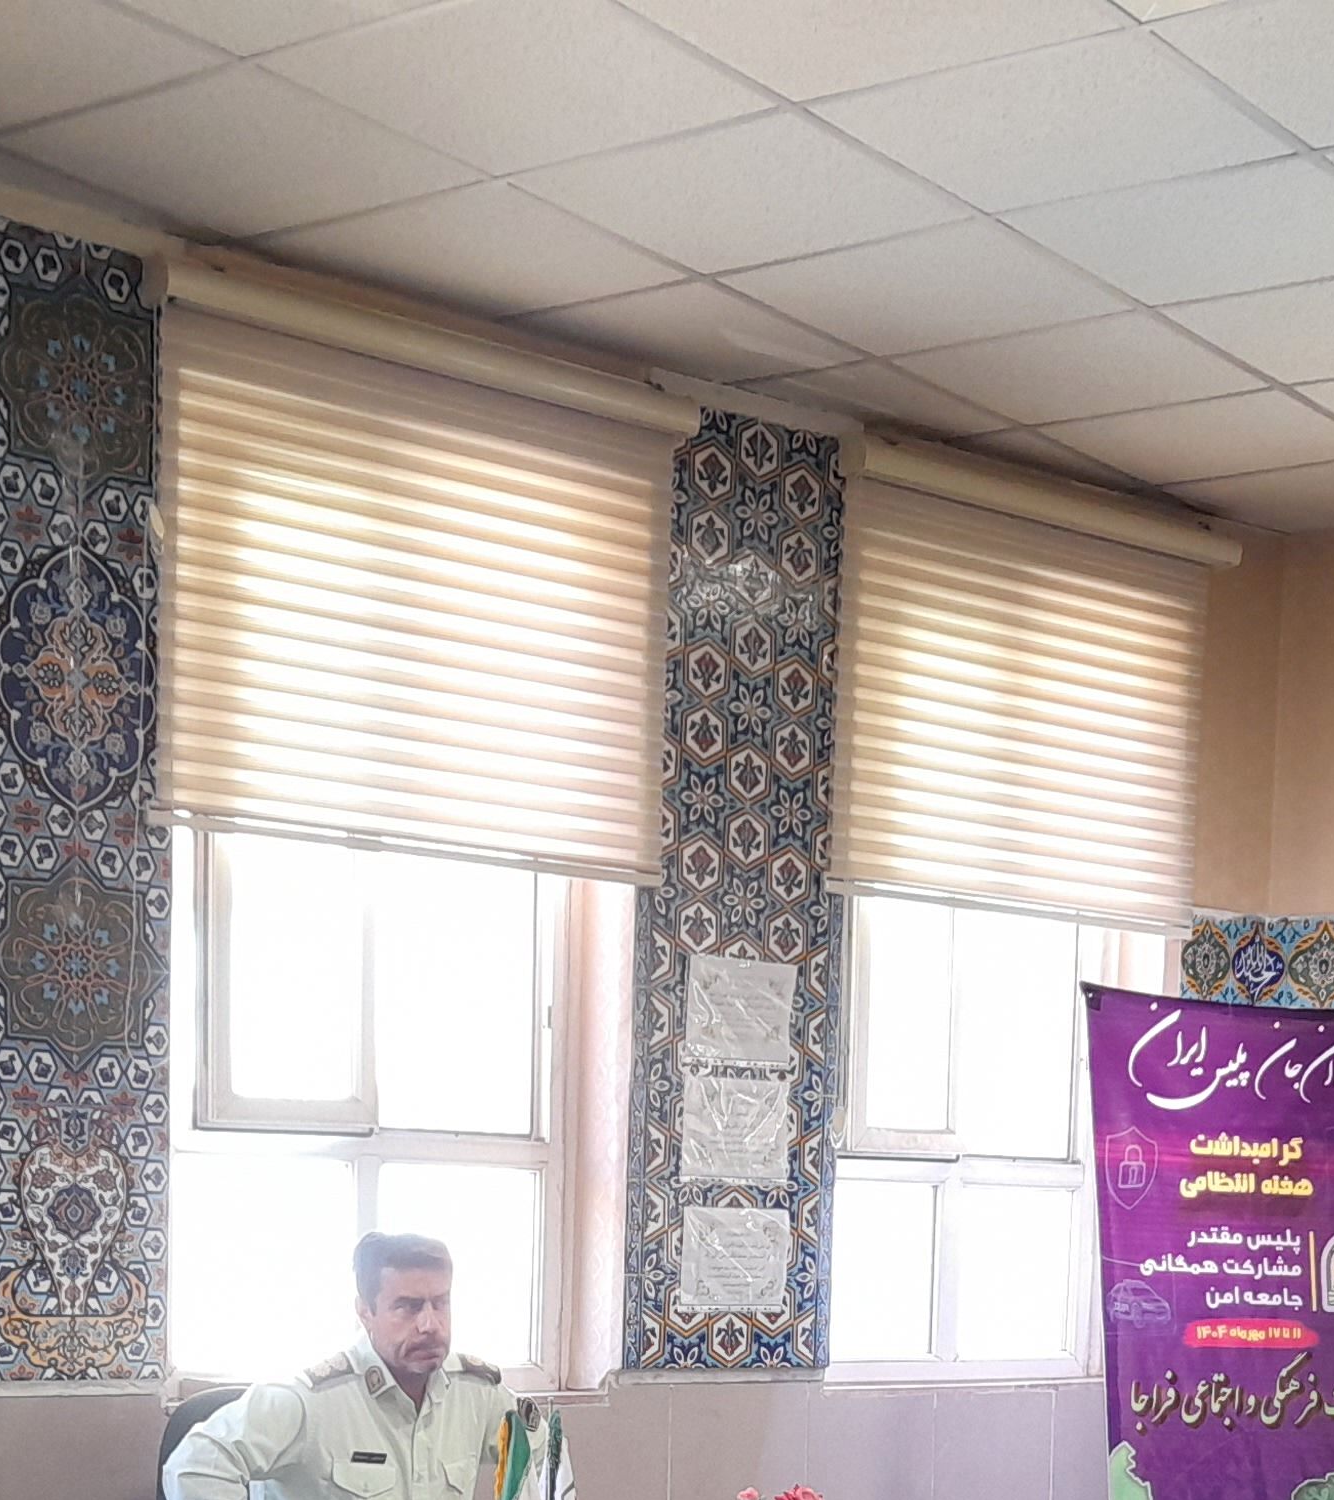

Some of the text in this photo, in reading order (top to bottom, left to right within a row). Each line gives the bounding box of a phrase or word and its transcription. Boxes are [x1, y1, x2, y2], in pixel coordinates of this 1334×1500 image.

[1128, 1002, 1207, 1087] ایران
[1255, 1021, 1302, 1099] جان
[1146, 1042, 1250, 1110] پلیس
[1179, 1170, 1314, 1198] هفته انتظامی
[1187, 1226, 1301, 1254] پلیس مقتدر
[1139, 1253, 1302, 1280] مشارکت همگانی
[1205, 1286, 1303, 1311] جامعه امن
[1196, 1325, 1227, 1339] ۱۴۰۴
[1131, 1370, 1175, 1431] فراجا
[1181, 1372, 1240, 1426] اجتماعی
[1246, 1394, 1256, 1415] و
[1260, 1351, 1319, 1425] فرهنگی
